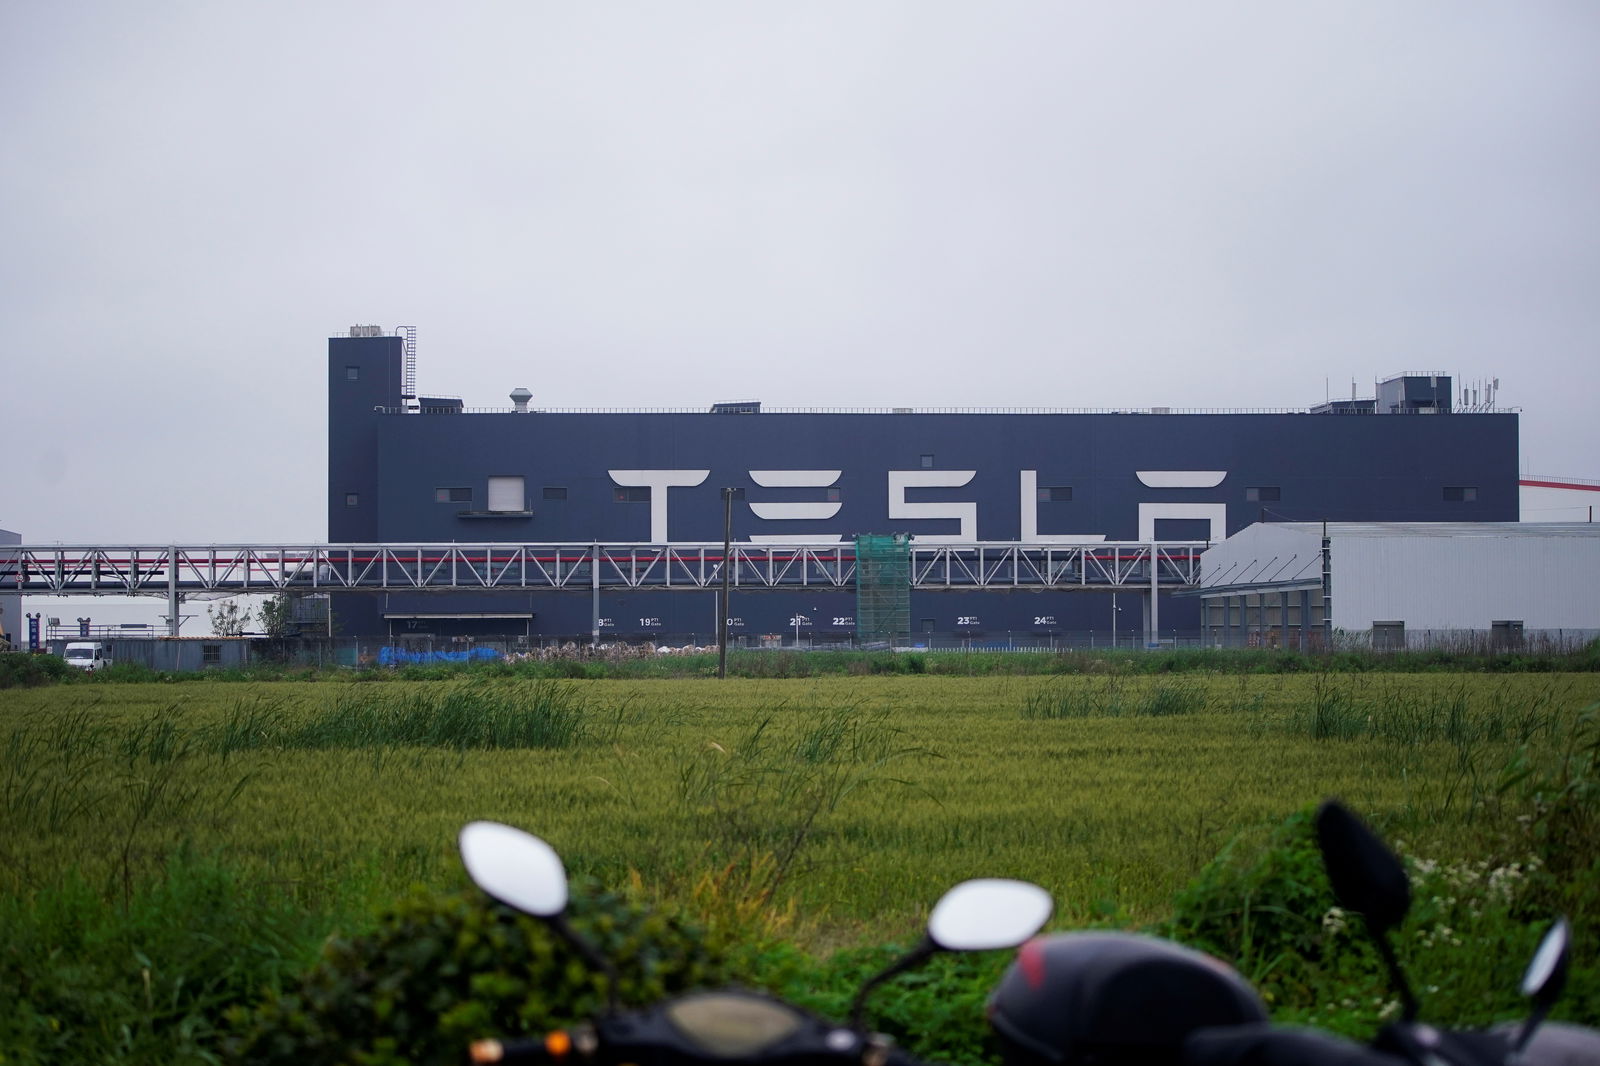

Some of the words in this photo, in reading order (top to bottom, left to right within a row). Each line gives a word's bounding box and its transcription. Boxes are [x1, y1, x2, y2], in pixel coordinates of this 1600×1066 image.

[608, 470, 1228, 551] TESLA
[640, 618, 650, 626] 19
[832, 618, 844, 626] 22
[958, 616, 970, 624] 23
[1034, 616, 1046, 624] 24
